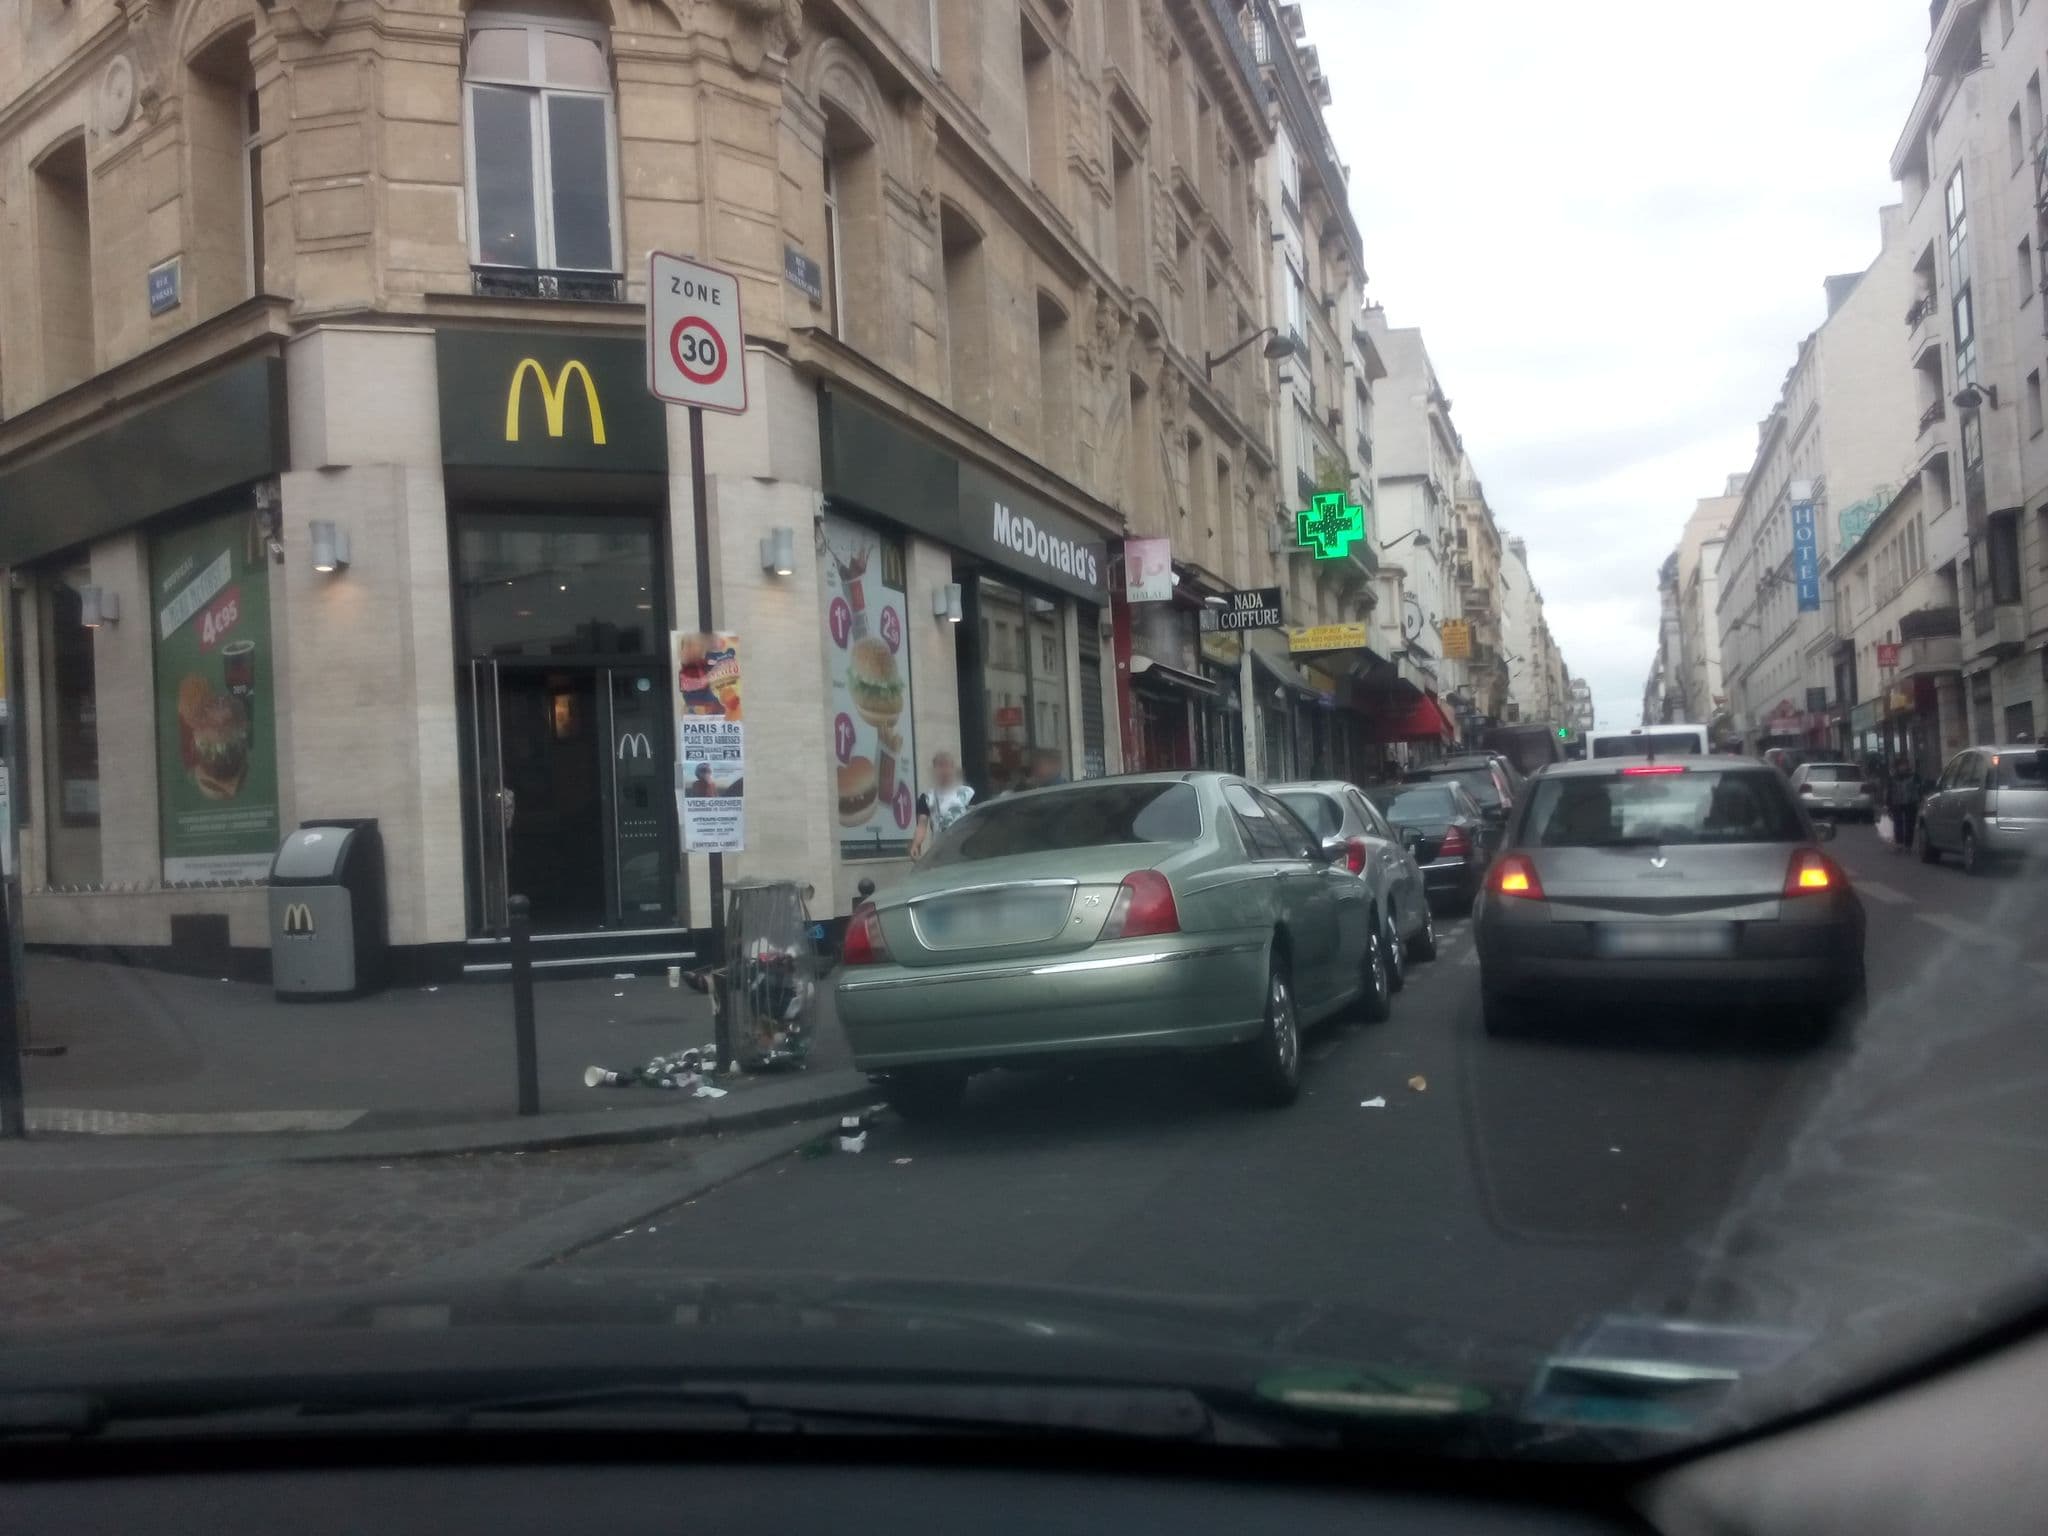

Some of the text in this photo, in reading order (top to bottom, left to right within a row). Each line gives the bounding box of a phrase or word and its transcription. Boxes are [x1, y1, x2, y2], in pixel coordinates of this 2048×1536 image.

[671, 276, 721, 306] ZONE
[682, 334, 716, 366] 30
[993, 502, 1098, 586] McDonald's
[1795, 509, 1815, 599] HOTEL
[1132, 591, 1165, 601] HALAL
[1234, 592, 1264, 610] NADA
[1221, 608, 1280, 629] COIFFURE
[684, 724, 740, 734] PARIS 18e
[684, 735, 701, 745] PLACE
[703, 735, 713, 745] DES
[687, 799, 742, 807] VIDE-GRENIER
[1084, 894, 1100, 905] 75
